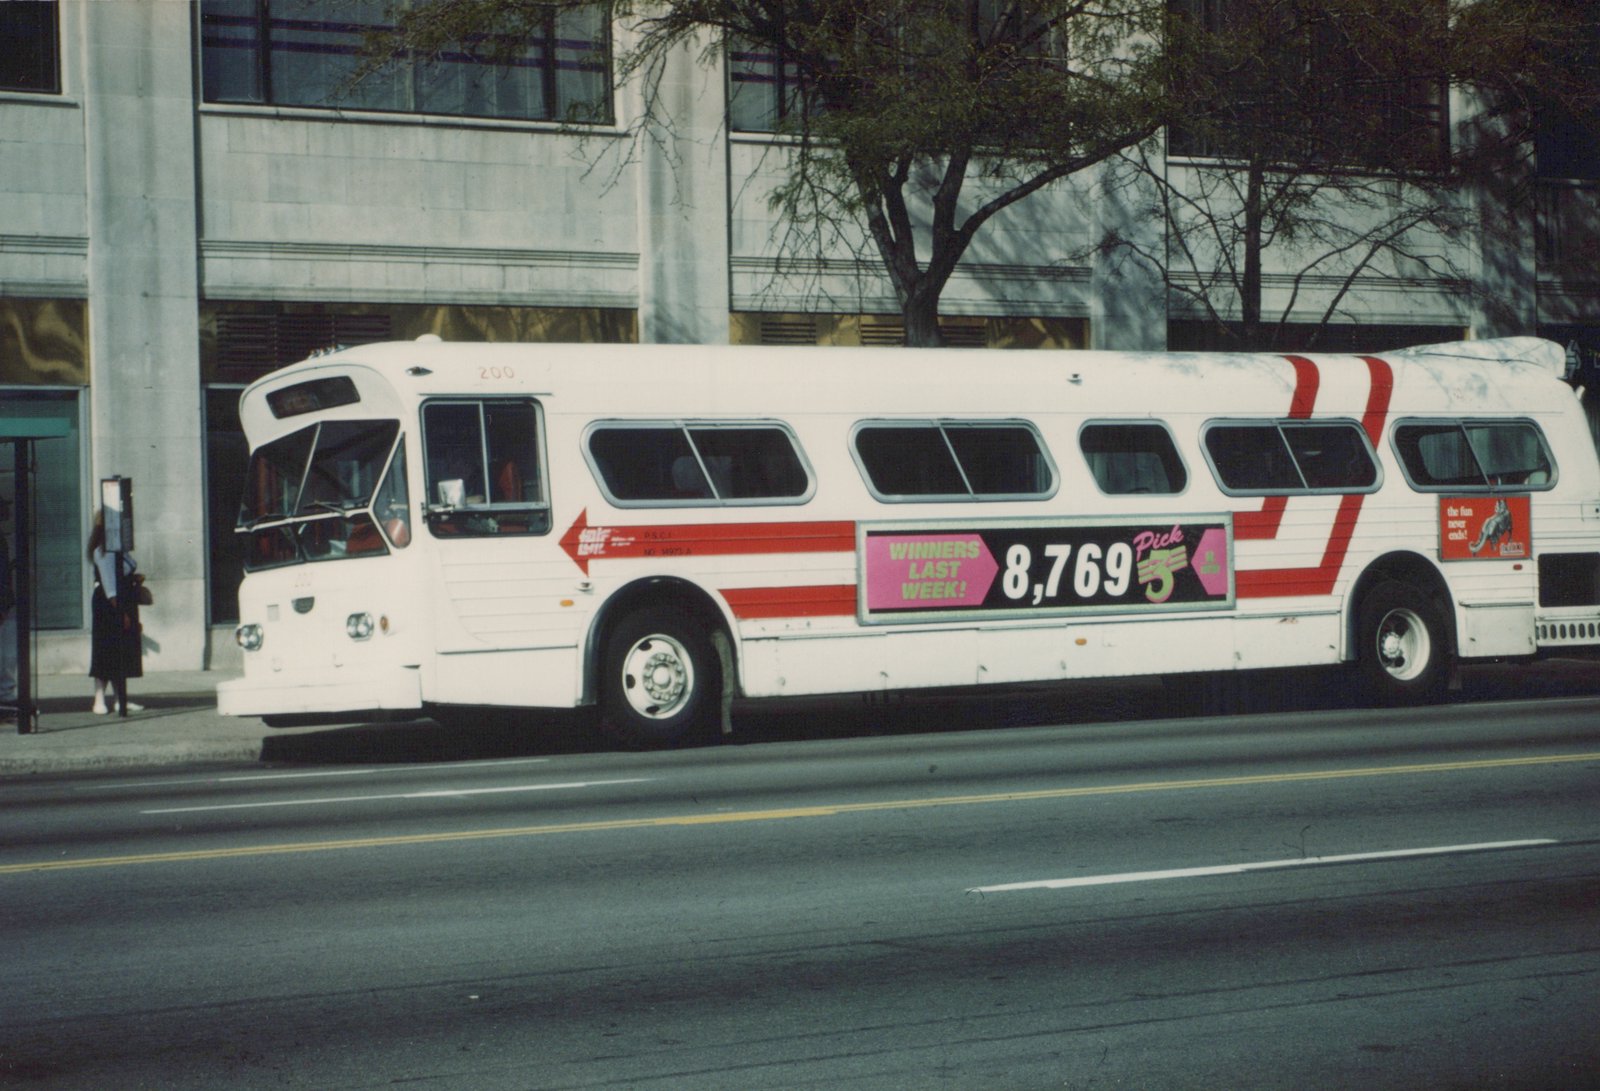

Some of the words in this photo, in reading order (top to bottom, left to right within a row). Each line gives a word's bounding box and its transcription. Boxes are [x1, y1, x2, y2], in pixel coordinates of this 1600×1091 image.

[478, 366, 514, 380] 200
[1447, 506, 1459, 517] the
[1460, 505, 1473, 517] fun
[1447, 520, 1467, 529] never
[1133, 524, 1184, 562] Pick
[1448, 530, 1468, 541] ends!
[889, 541, 981, 560] WINNERS
[909, 561, 961, 580] LAST
[1002, 542, 1133, 605] 8,769
[902, 581, 967, 600] WEEK!
